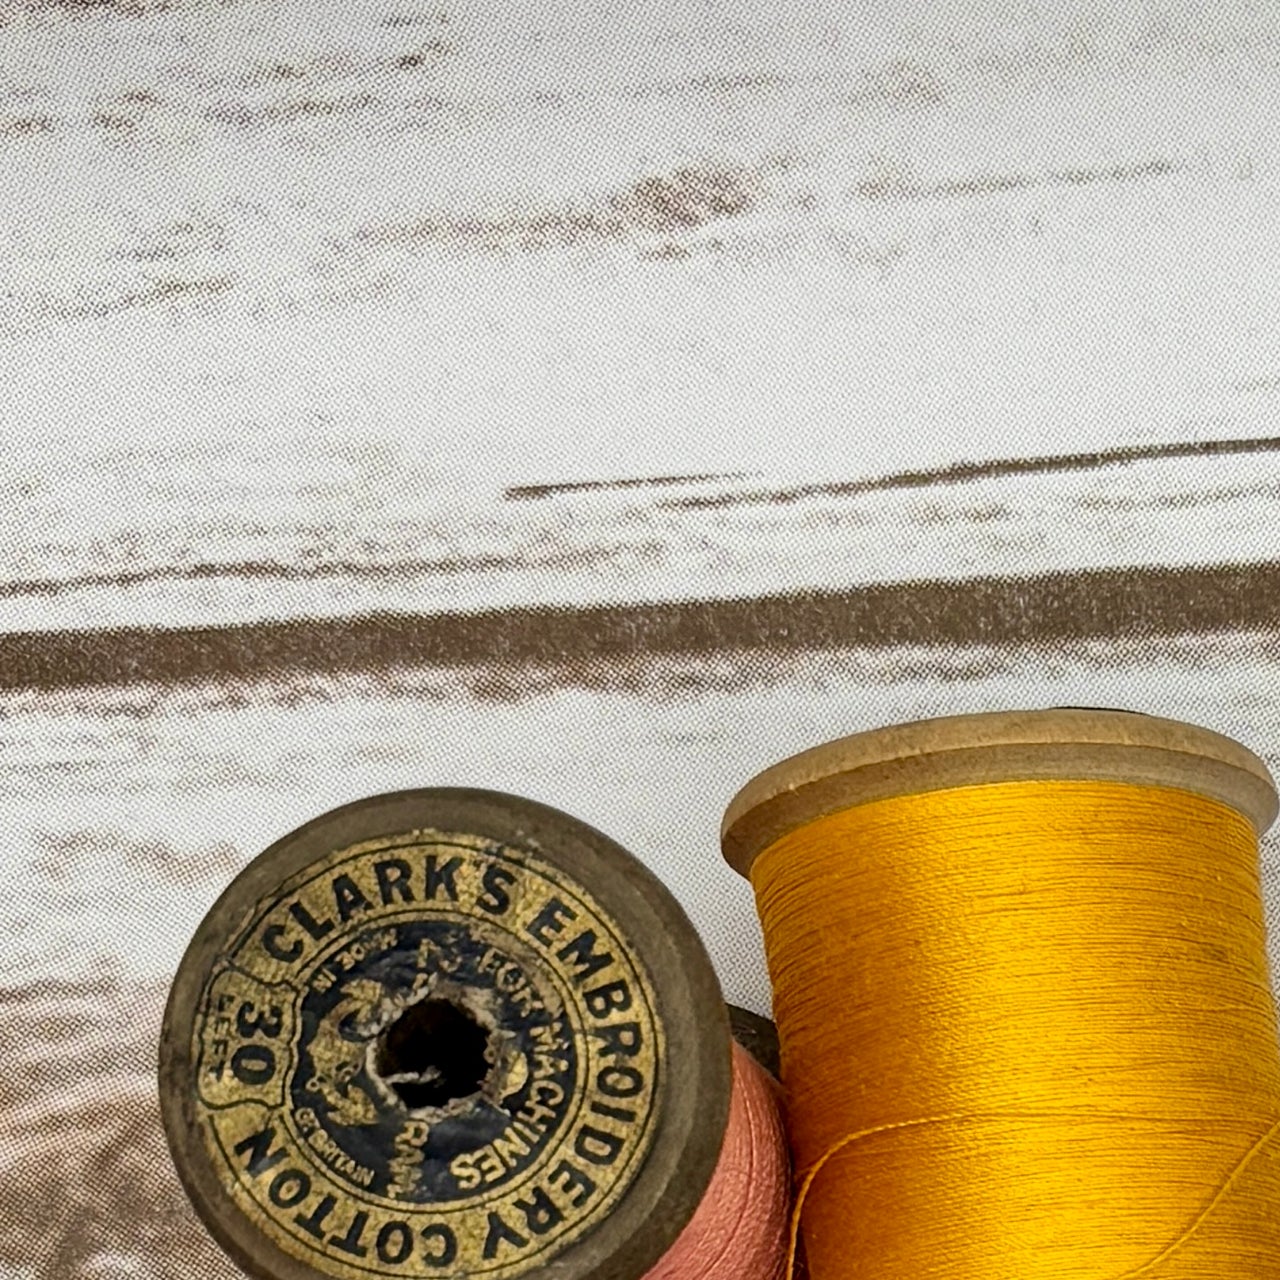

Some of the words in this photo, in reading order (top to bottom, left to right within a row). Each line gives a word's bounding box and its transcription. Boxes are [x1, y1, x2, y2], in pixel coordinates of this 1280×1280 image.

[231, 1000, 284, 1085] 30
[450, 1021, 570, 1192] MACHINES
[483, 898, 644, 1260] EMBROIDERY
[234, 1128, 457, 1268] COTTON
